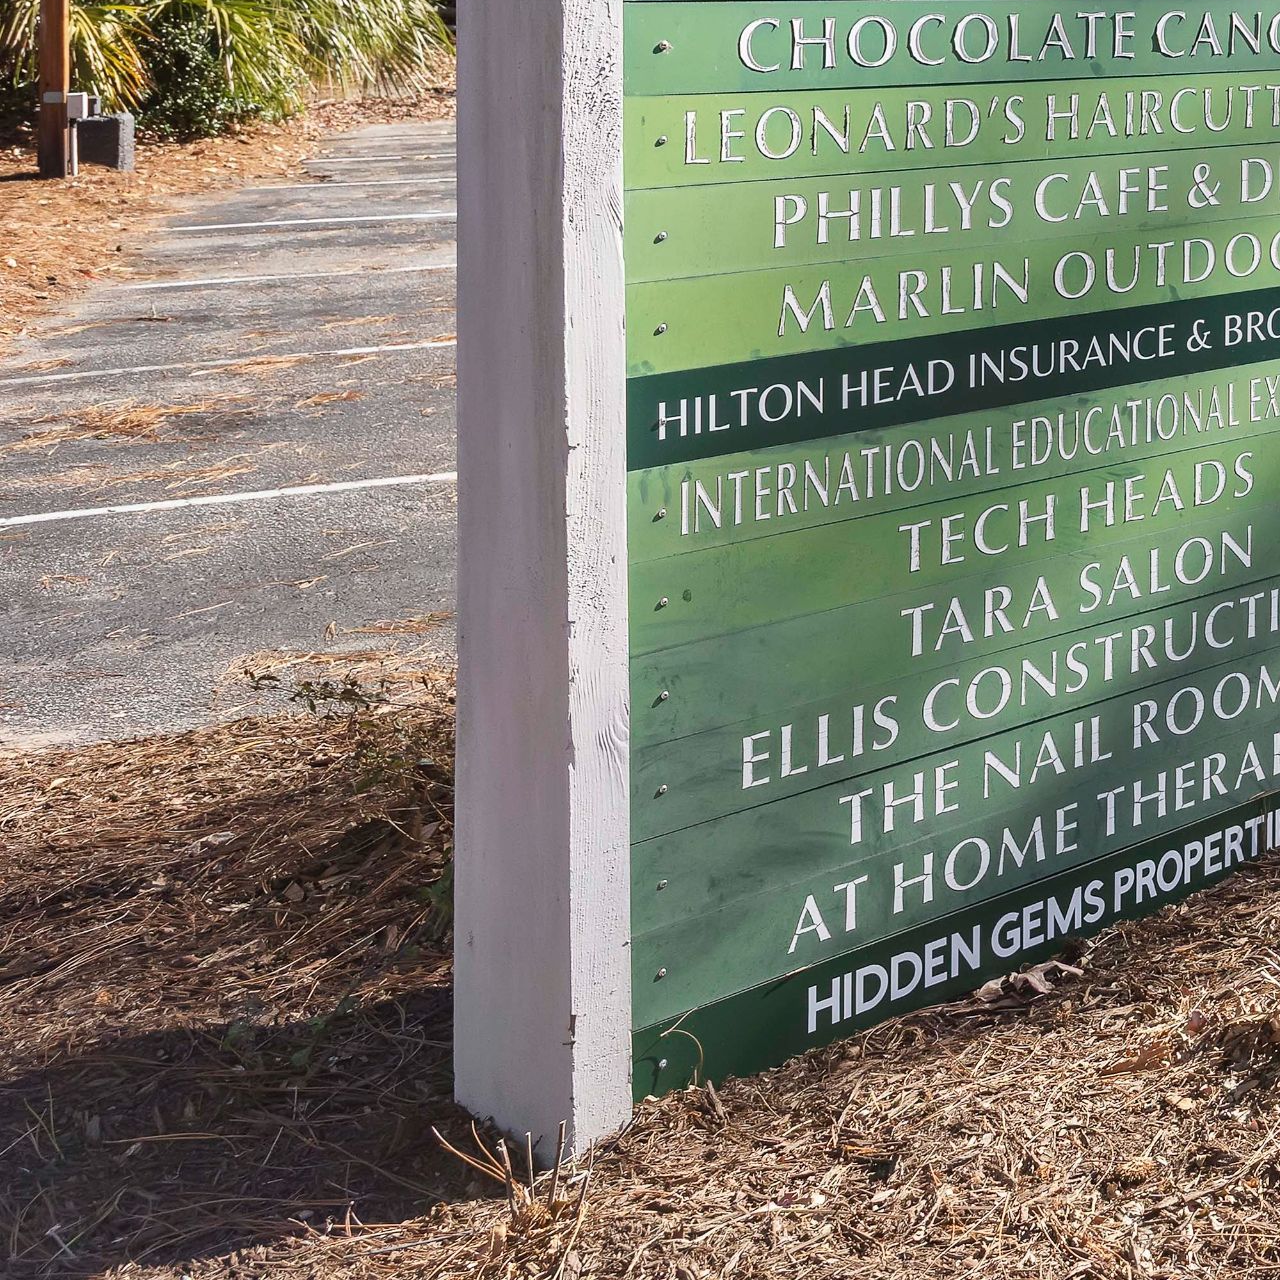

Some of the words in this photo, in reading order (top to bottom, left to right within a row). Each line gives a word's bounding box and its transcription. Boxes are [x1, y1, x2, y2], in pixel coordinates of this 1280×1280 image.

[738, 11, 1136, 73] CHOCOLATE
[685, 94, 1025, 166] LEONARD'S
[773, 178, 1013, 248] PHILLYS
[1034, 165, 1169, 223] CAFE
[1187, 161, 1220, 209] &
[778, 257, 1029, 338] MARLIN
[657, 378, 824, 441] HILTON
[842, 358, 954, 410] HEAD
[970, 324, 1176, 388] INSURANCE
[1187, 320, 1212, 352] &
[679, 413, 1000, 537] INTERNATIONAL
[1011, 383, 1239, 471] EDUCATIONAL
[898, 494, 1057, 573] TECH
[1080, 451, 1255, 533] HEADS
[900, 576, 1060, 658] TARA
[1080, 525, 1253, 613] SALON
[741, 695, 899, 791] ELLIS
[839, 760, 961, 845] THE
[984, 715, 1113, 800] NAIL
[787, 875, 867, 954] AT
[894, 803, 1079, 916] HOME
[807, 933, 981, 1034] HIDDEN
[990, 880, 1105, 958] GEMS
